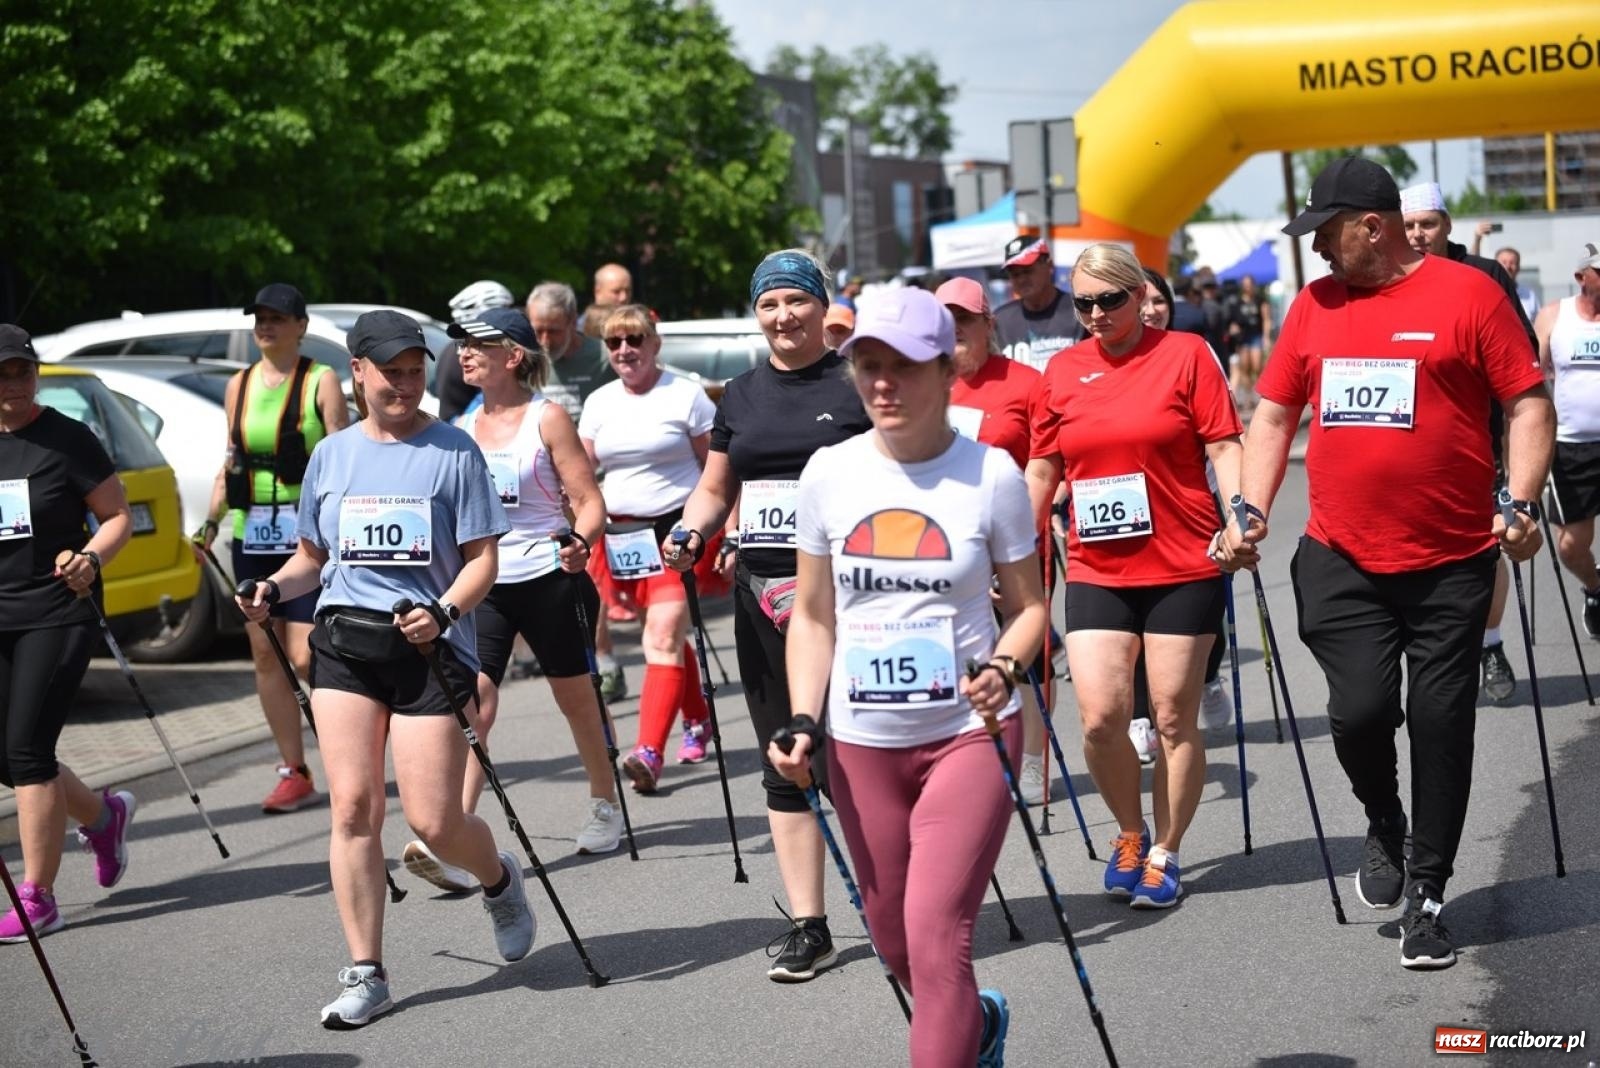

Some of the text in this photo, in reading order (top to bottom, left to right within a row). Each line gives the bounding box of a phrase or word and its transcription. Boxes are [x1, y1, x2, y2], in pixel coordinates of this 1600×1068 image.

[1299, 53, 1437, 91] MIASTO
[1584, 341, 1600, 353] 10
[1345, 386, 1389, 408] 107
[379, 497, 394, 505] BEZ
[394, 497, 425, 505] GRANIC
[758, 507, 796, 529] 104
[1090, 501, 1126, 524] 126
[254, 525, 282, 541] 105
[363, 524, 403, 546] 110
[616, 550, 644, 568] 122
[839, 567, 952, 594] ellesse
[884, 622, 901, 632] BEZ
[870, 656, 917, 685] 115
